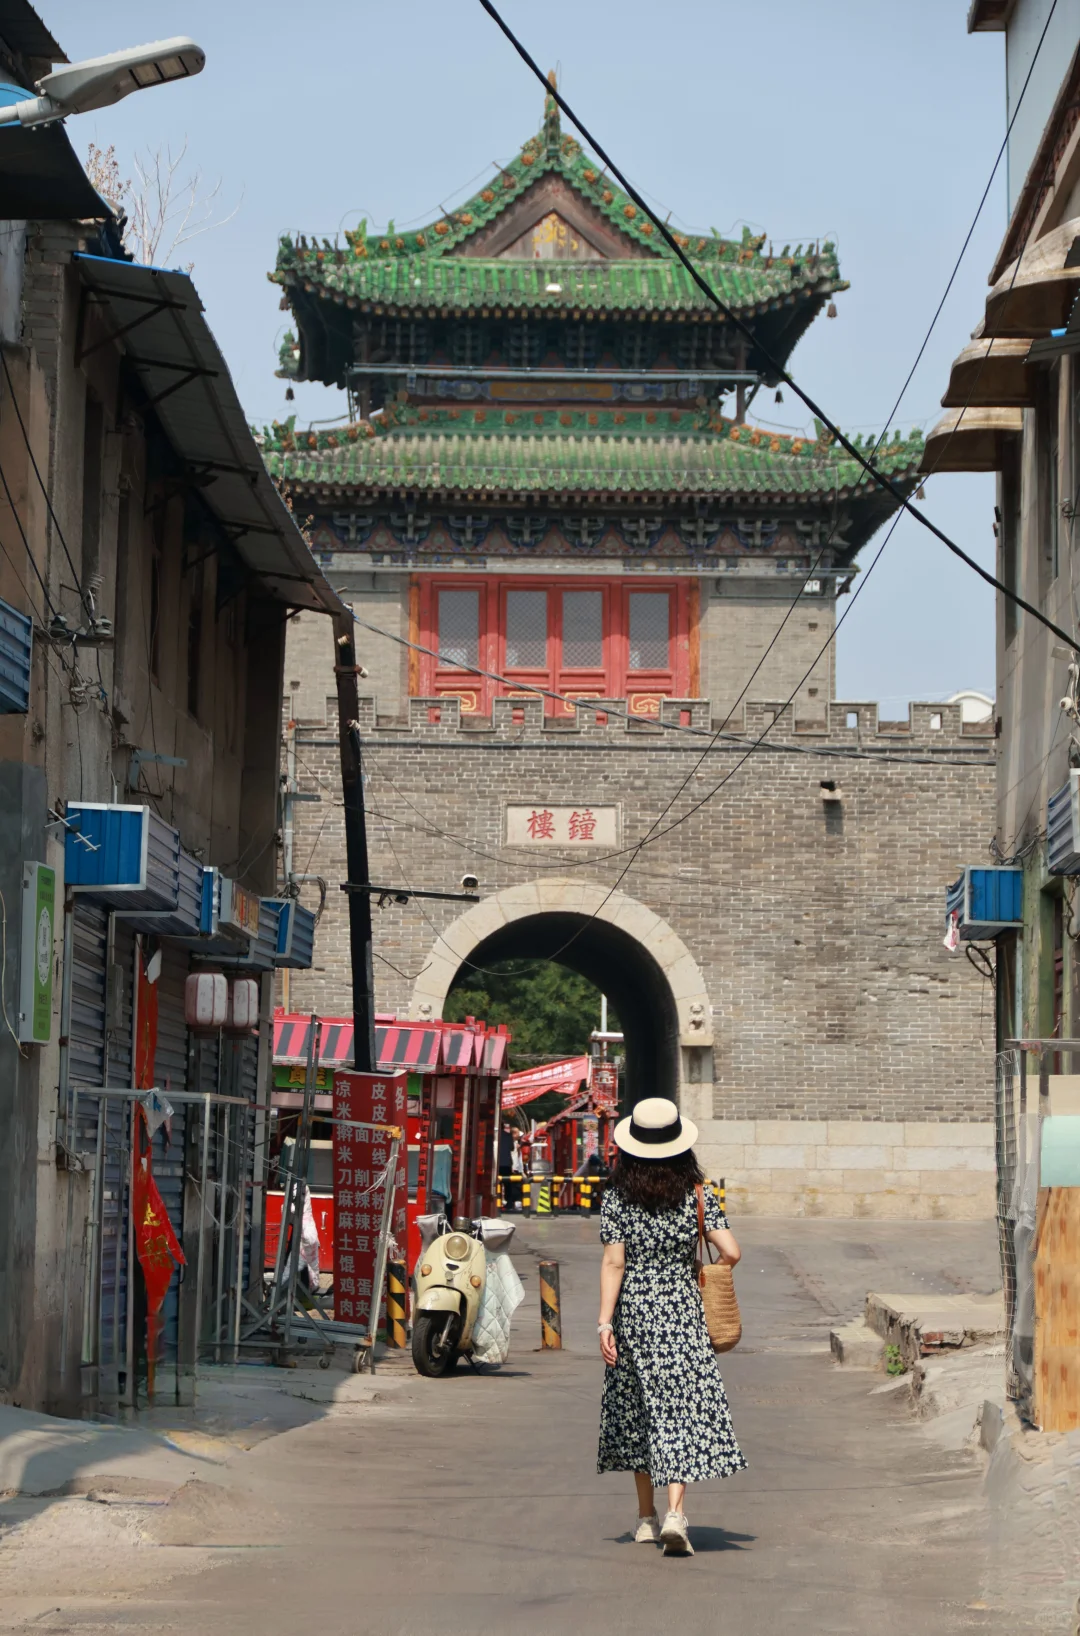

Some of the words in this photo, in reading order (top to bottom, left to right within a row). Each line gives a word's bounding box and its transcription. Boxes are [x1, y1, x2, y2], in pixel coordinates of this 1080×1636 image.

[336, 1080, 387, 1100] 凉皮
[336, 1102, 387, 1122] 米皮
[337, 1146, 387, 1166] 米线
